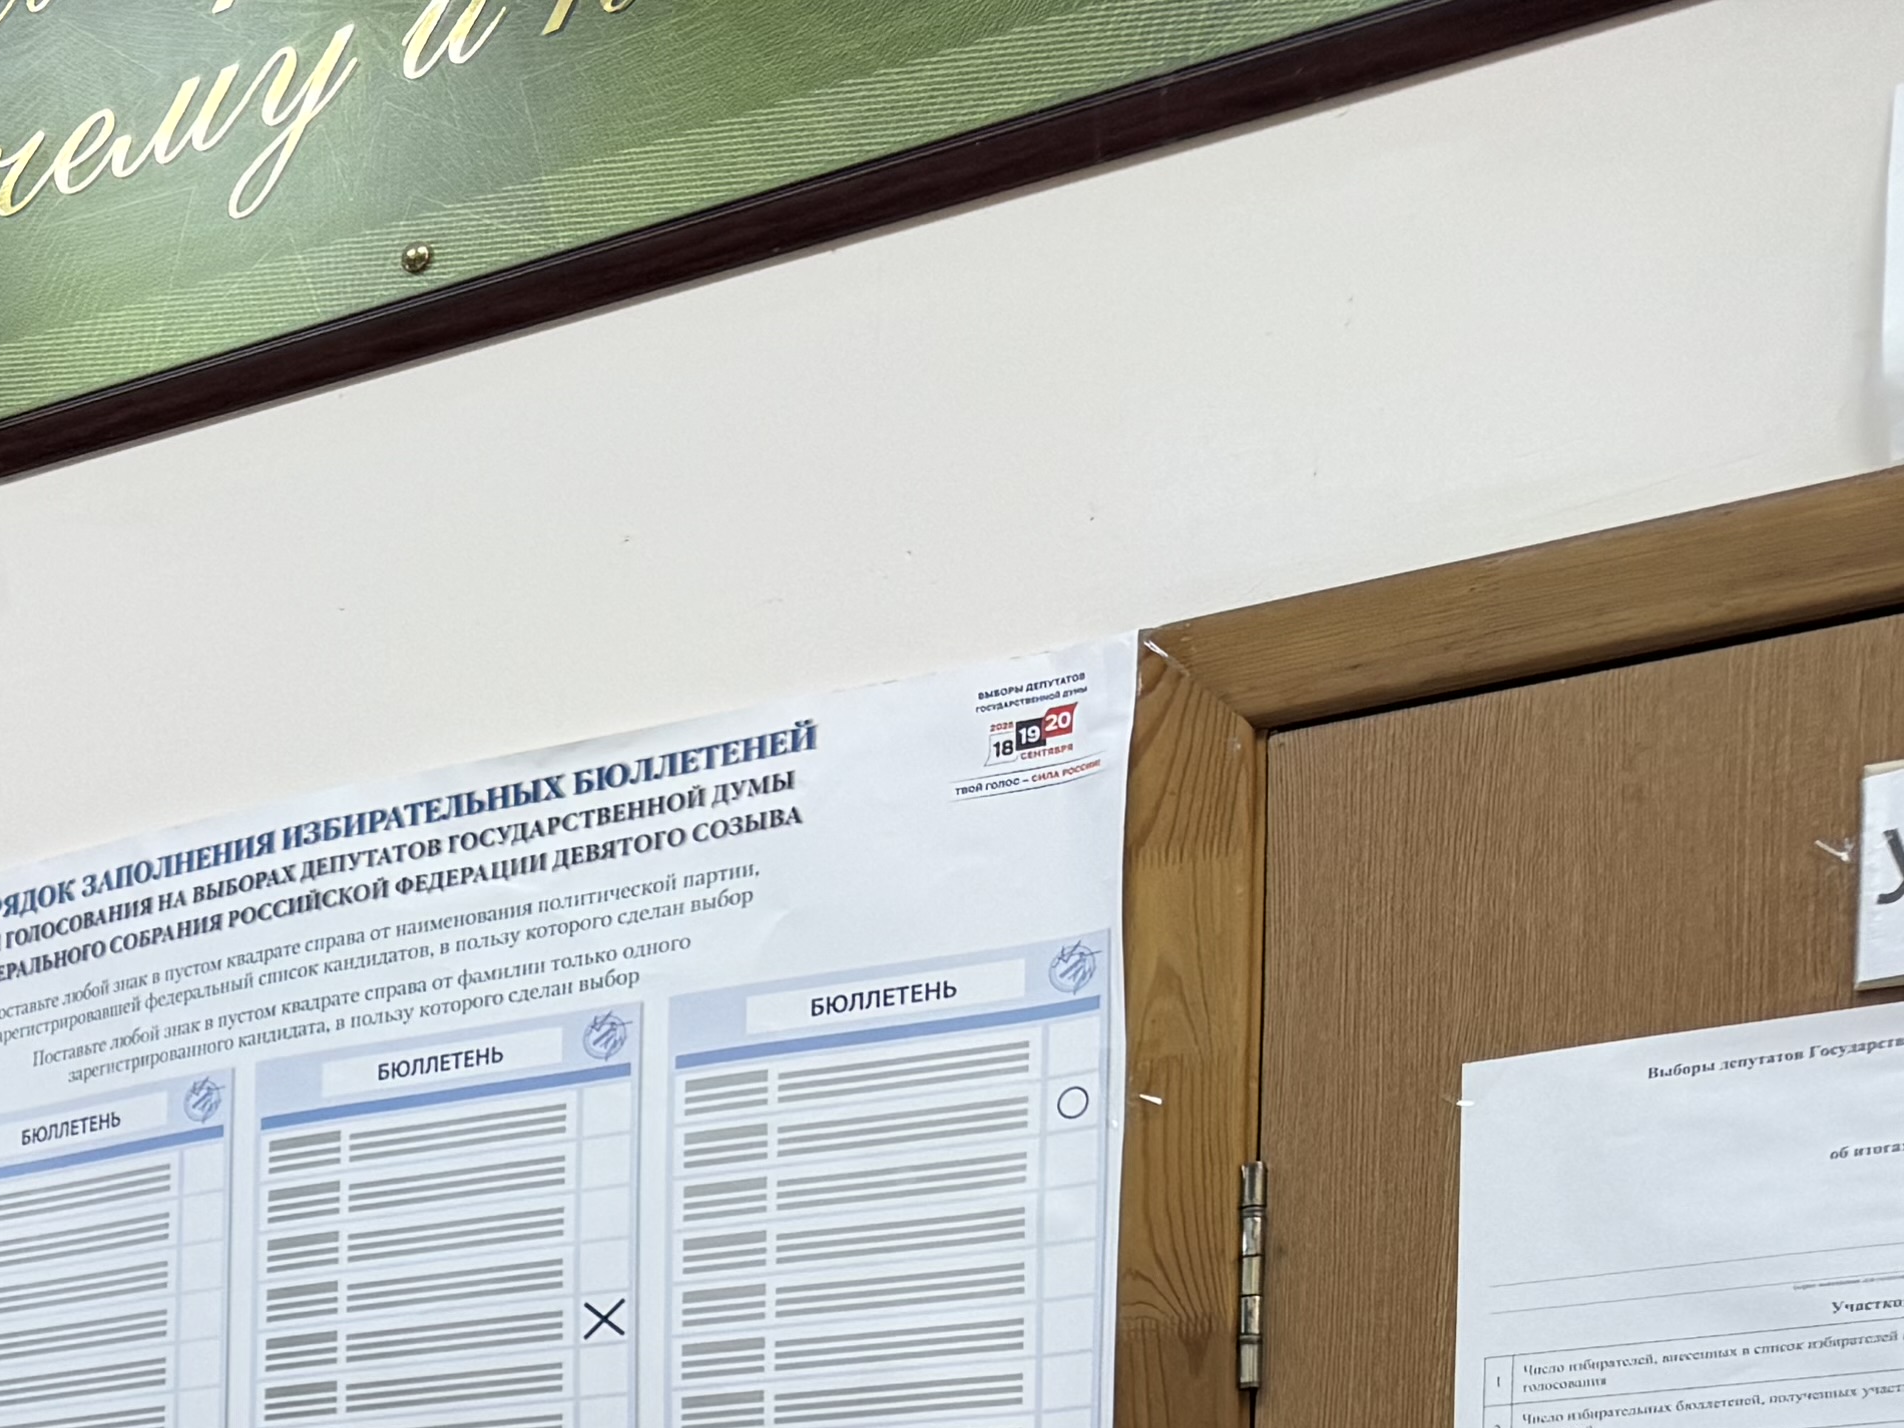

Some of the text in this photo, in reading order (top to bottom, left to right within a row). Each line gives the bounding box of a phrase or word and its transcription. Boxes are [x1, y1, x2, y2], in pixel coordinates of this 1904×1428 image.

[976, 690, 1060, 713] ГОСУДАРСТВЕННОЙ
[978, 672, 1086, 700] ВЫБОРЫ ДЕПУТАТОВ
[993, 711, 1071, 758] 18 19 20
[1020, 743, 1073, 760] СЕНТЯБРЯ
[955, 782, 983, 796] ТВОЙ
[985, 777, 1020, 791] ГОЛОС
[1031, 770, 1060, 783] СИЛА
[81, 830, 275, 898] ЗАПОЛНЕНИЯ
[281, 773, 566, 851] ИЗБИРАТЕЛЬНЫХ
[572, 718, 817, 796] БЮЛЛЕТЕНЕЙ
[5, 896, 153, 950] ГОЛОСОВАНИЯ
[157, 890, 187, 912] НА
[192, 863, 296, 904] ВЫБОРАХ
[299, 838, 442, 884] ДЕПУТАТОВ
[447, 784, 706, 854] ГОСУДАРСТВЕННОЙ
[710, 769, 795, 809] ДУМЫ
[109, 913, 223, 954] СОБРАНИЯ
[228, 876, 389, 929] РОССИЙСКОЙ
[394, 852, 547, 896] ФЕДЕРАЦИИ
[551, 827, 687, 873] ДЕВЯТОГО
[691, 806, 803, 843] СОЗЫВА
[61, 979, 109, 1006] любой
[112, 973, 148, 995] знак
[151, 972, 161, 985] в
[164, 958, 222, 984] пустом
[226, 942, 300, 975] квадрате
[304, 931, 365, 954] справа
[369, 926, 391, 942] от
[395, 902, 532, 937] наименования
[538, 872, 676, 914] политической
[683, 863, 760, 890] партии,
[144, 972, 253, 1013] федеральный
[257, 963, 319, 987] список
[323, 945, 434, 974] кандидатов,
[439, 942, 450, 955] в
[455, 930, 521, 952] пользу
[525, 914, 613, 941] которого
[616, 902, 684, 926] сделан
[690, 888, 753, 913] выбор
[32, 937, 691, 1068] Поставьте любой знак в пустом квадрате справа от фамилии только одного
[810, 979, 958, 1018] БЮЛЛЕТЕНЬ
[67, 968, 640, 1084] зарегистрированного кандидата, в пользу которого сделан выбор
[377, 1043, 504, 1082] БЮЛЛЕТЕНЬ
[1647, 1062, 1715, 1080] Выборы
[1719, 1051, 1804, 1071] депутатов
[20, 1110, 122, 1147] БЮЛЛЕТЕНЬ
